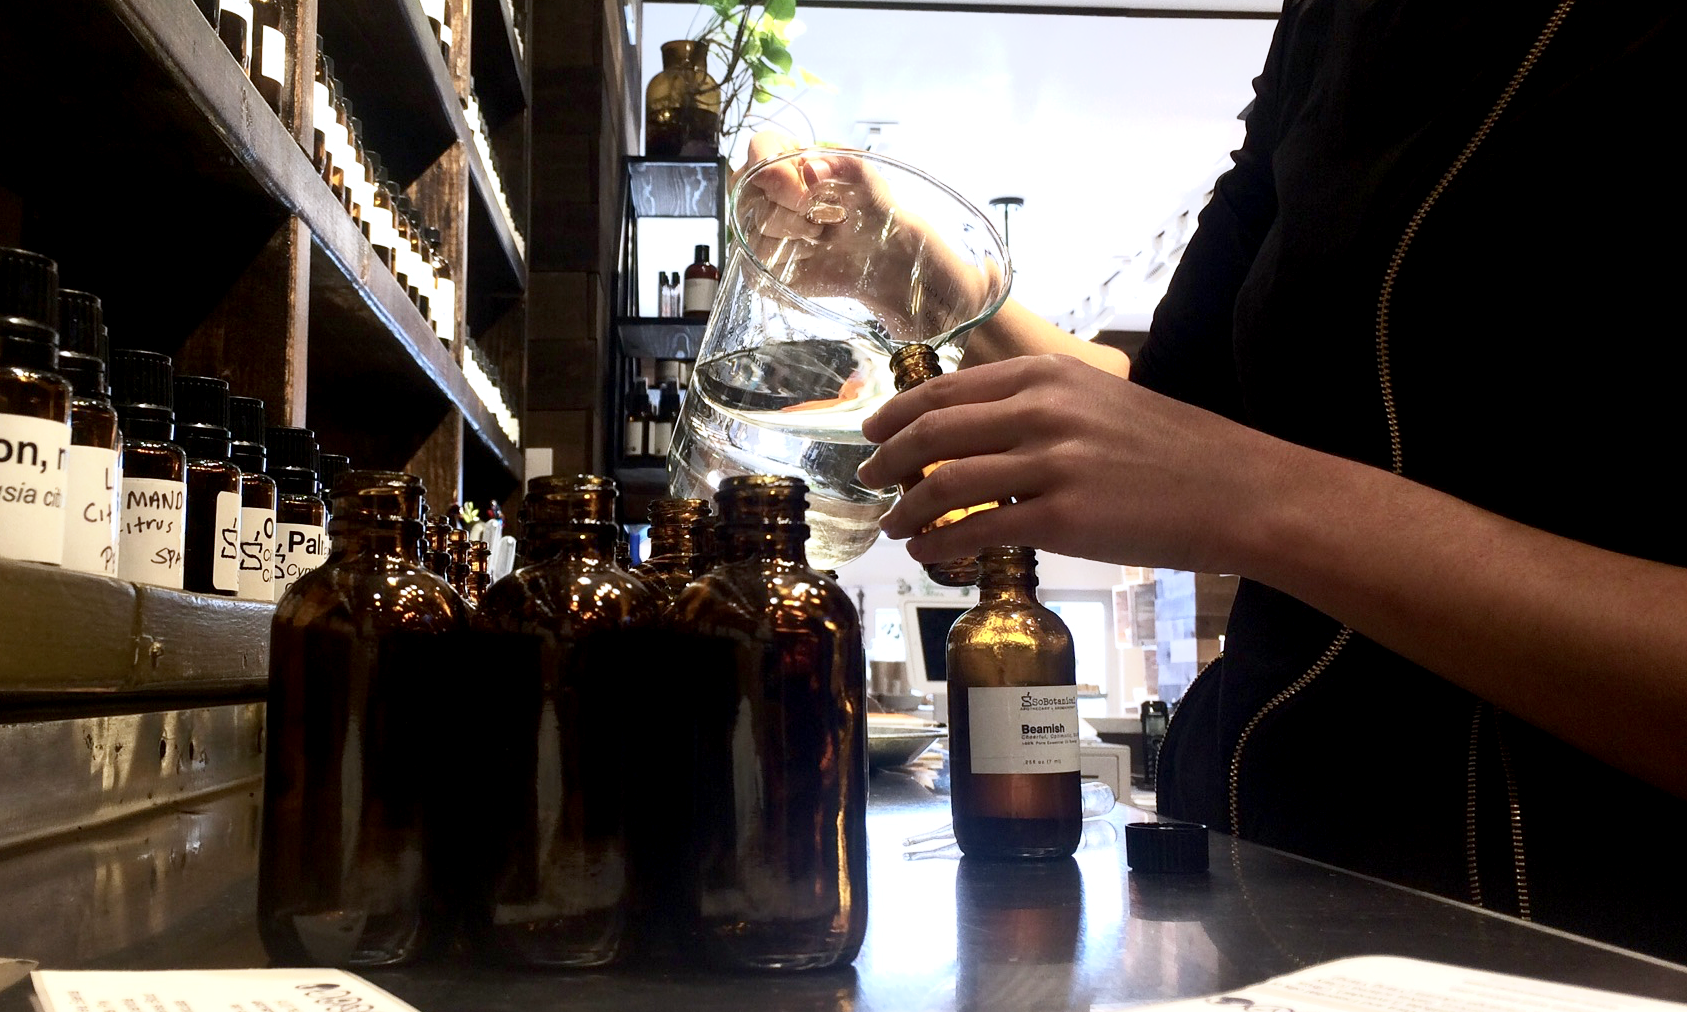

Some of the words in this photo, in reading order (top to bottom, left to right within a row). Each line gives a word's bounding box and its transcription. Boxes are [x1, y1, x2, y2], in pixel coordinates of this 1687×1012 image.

[0, 481, 37, 504] sia
[120, 516, 173, 534] itrus
[1021, 723, 1065, 735] Beamish
